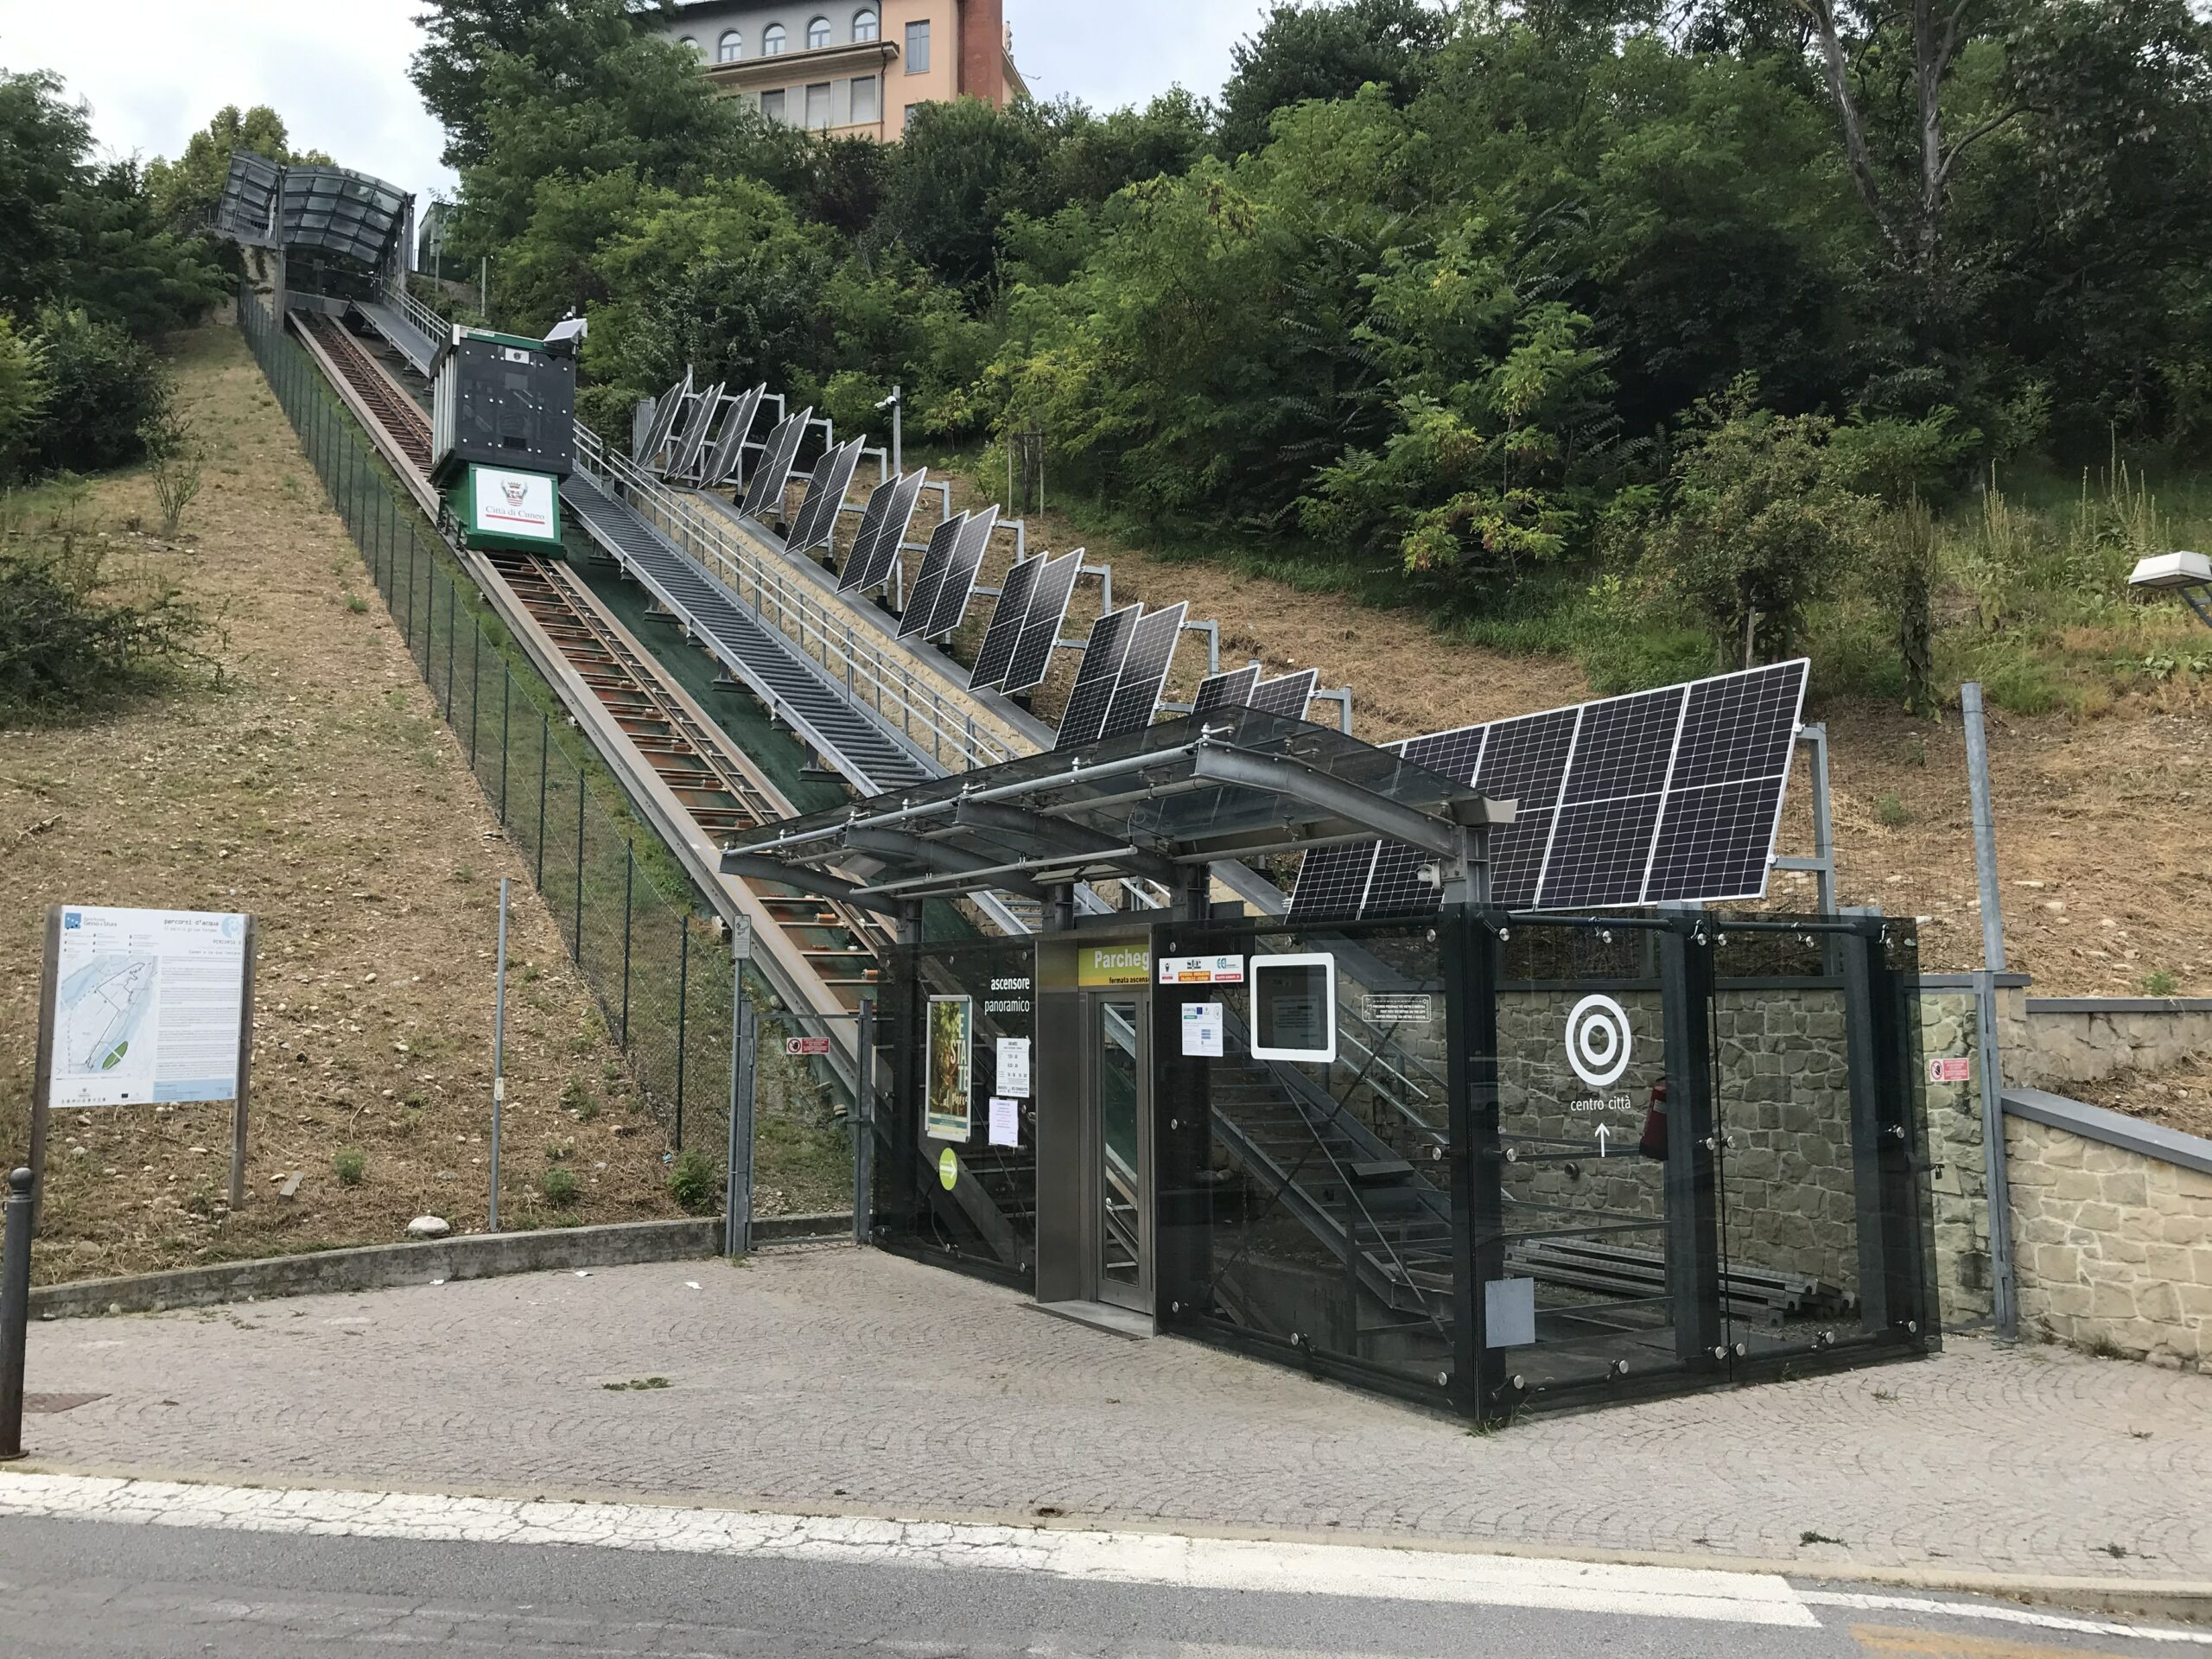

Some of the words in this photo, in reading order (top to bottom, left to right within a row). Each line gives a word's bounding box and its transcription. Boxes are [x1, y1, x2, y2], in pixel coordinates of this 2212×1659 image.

[486, 505, 506, 514] Città
[518, 510, 545, 519] Cuneo
[990, 977, 1030, 990] ascensore
[984, 996, 1030, 1016] panoramico
[958, 1014, 965, 1039] E
[950, 1039, 967, 1065] STA
[1570, 1098, 1605, 1111] centro
[1608, 1095, 1631, 1109] città
